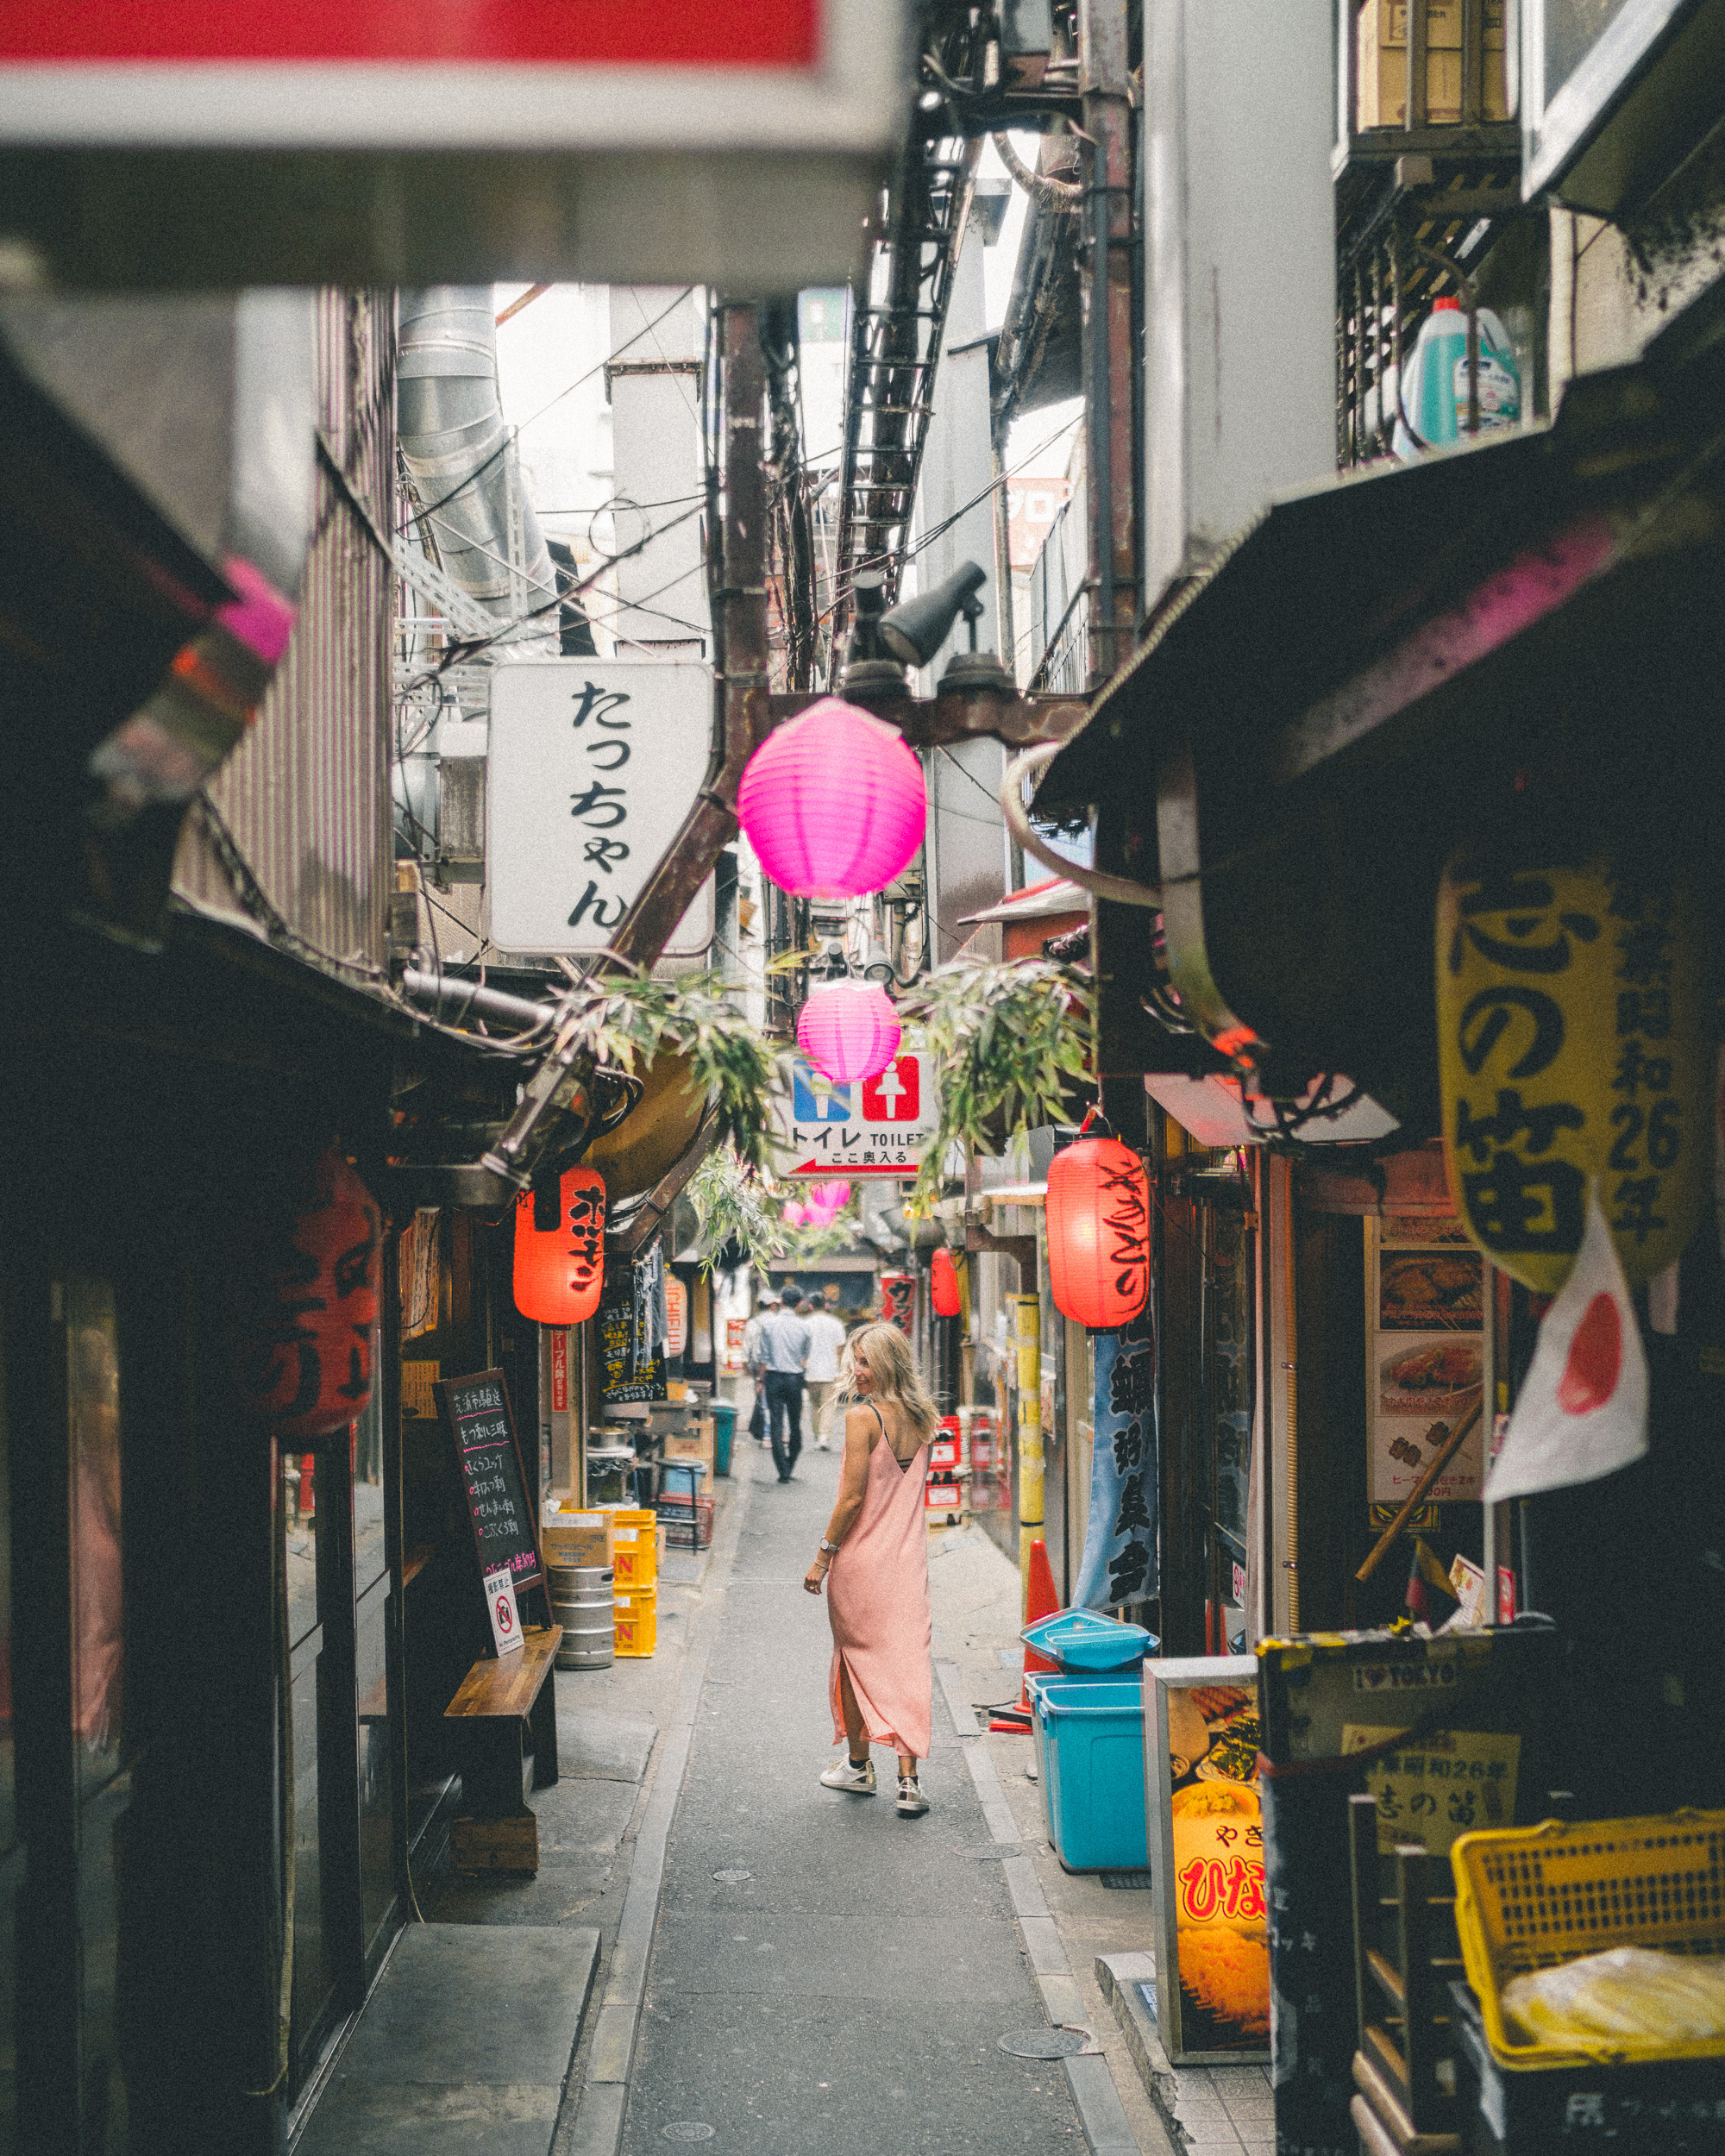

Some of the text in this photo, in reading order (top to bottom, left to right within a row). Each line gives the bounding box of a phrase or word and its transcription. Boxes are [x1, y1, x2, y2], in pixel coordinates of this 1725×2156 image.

[568, 681, 631, 929] たっちゃん
[793, 1126, 862, 1150] トイレ
[870, 1133, 924, 1147] TOILET
[831, 1151, 906, 1163] ここ奥入る
[1389, 1664, 1456, 1687] TOKYO
